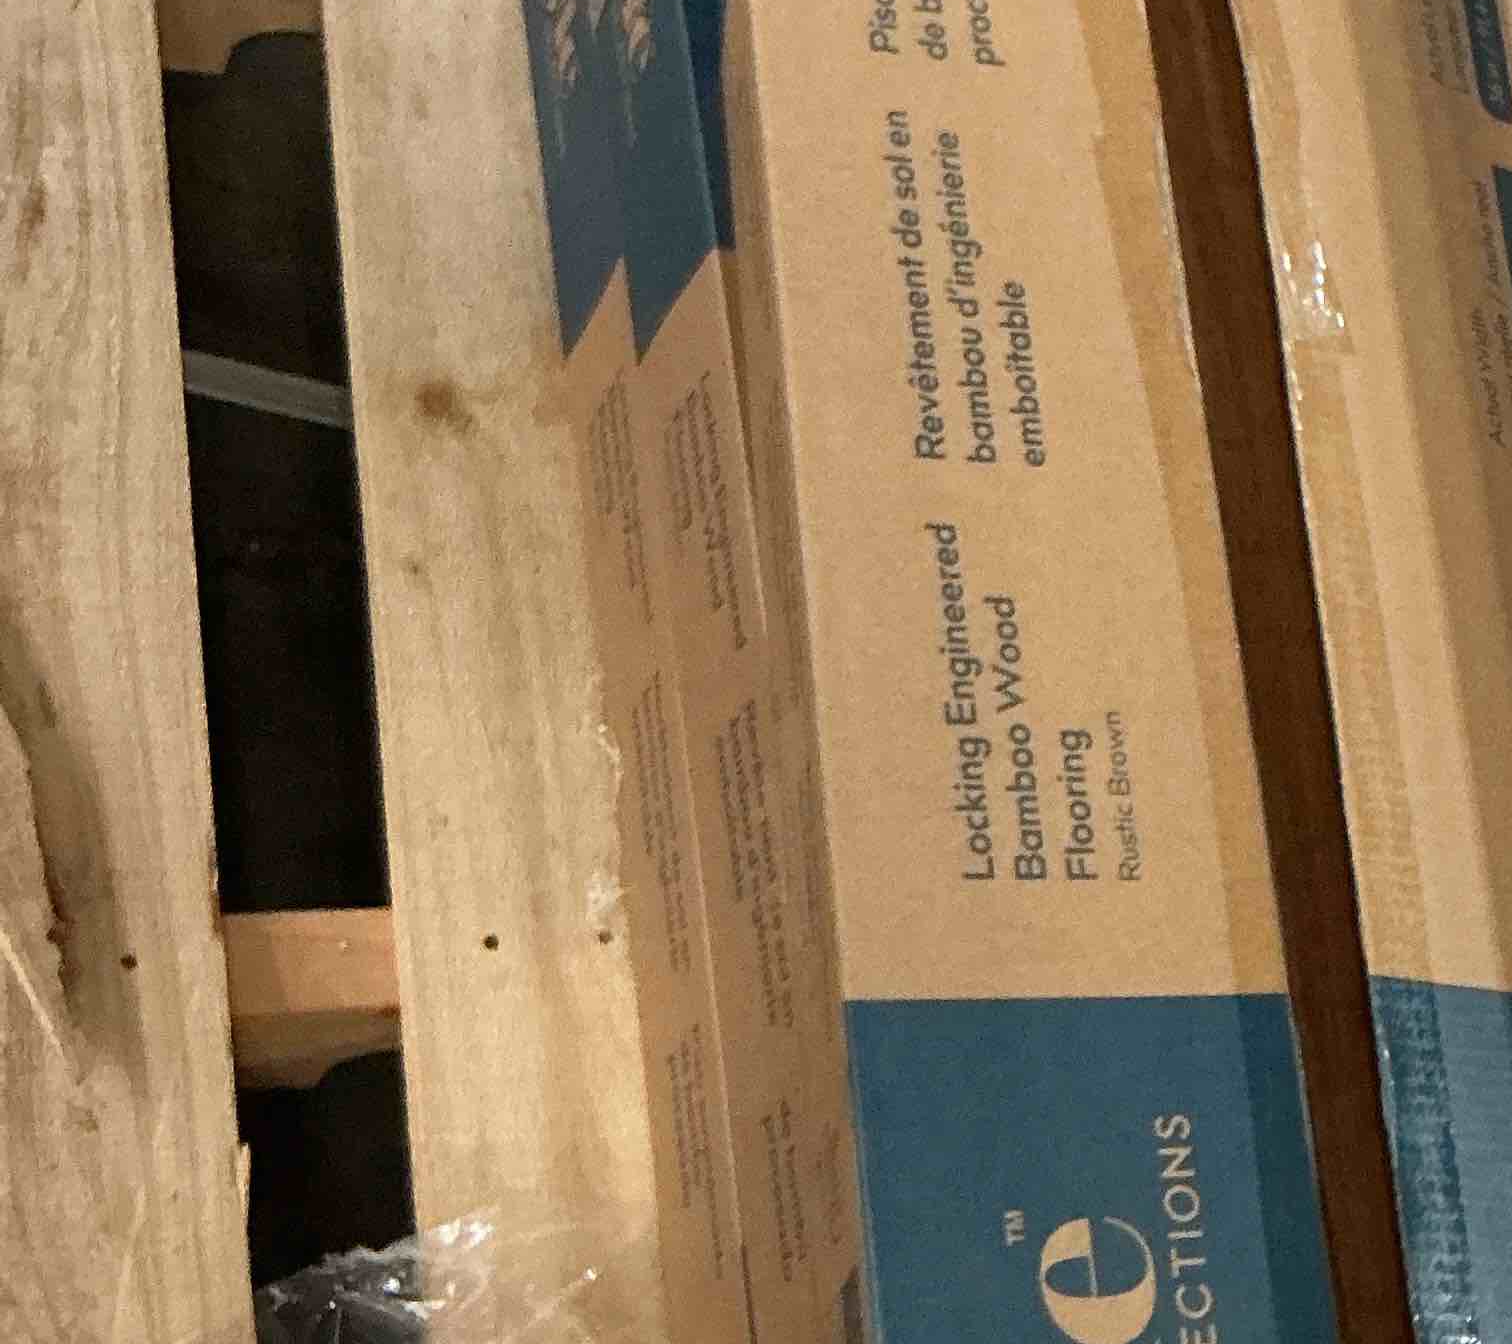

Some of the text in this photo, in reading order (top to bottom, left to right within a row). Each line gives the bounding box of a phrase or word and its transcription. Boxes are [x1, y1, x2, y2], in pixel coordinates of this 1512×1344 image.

[919, 22, 949, 61] de
[884, 109, 948, 461] Revêtement de sol en
[957, 323, 997, 464] bambou
[924, 520, 995, 881] Locking Engineered
[983, 594, 1048, 881] Bamboo Wood
[1056, 728, 1099, 881] Flooring
[1104, 710, 1141, 881] Rustic Brown
